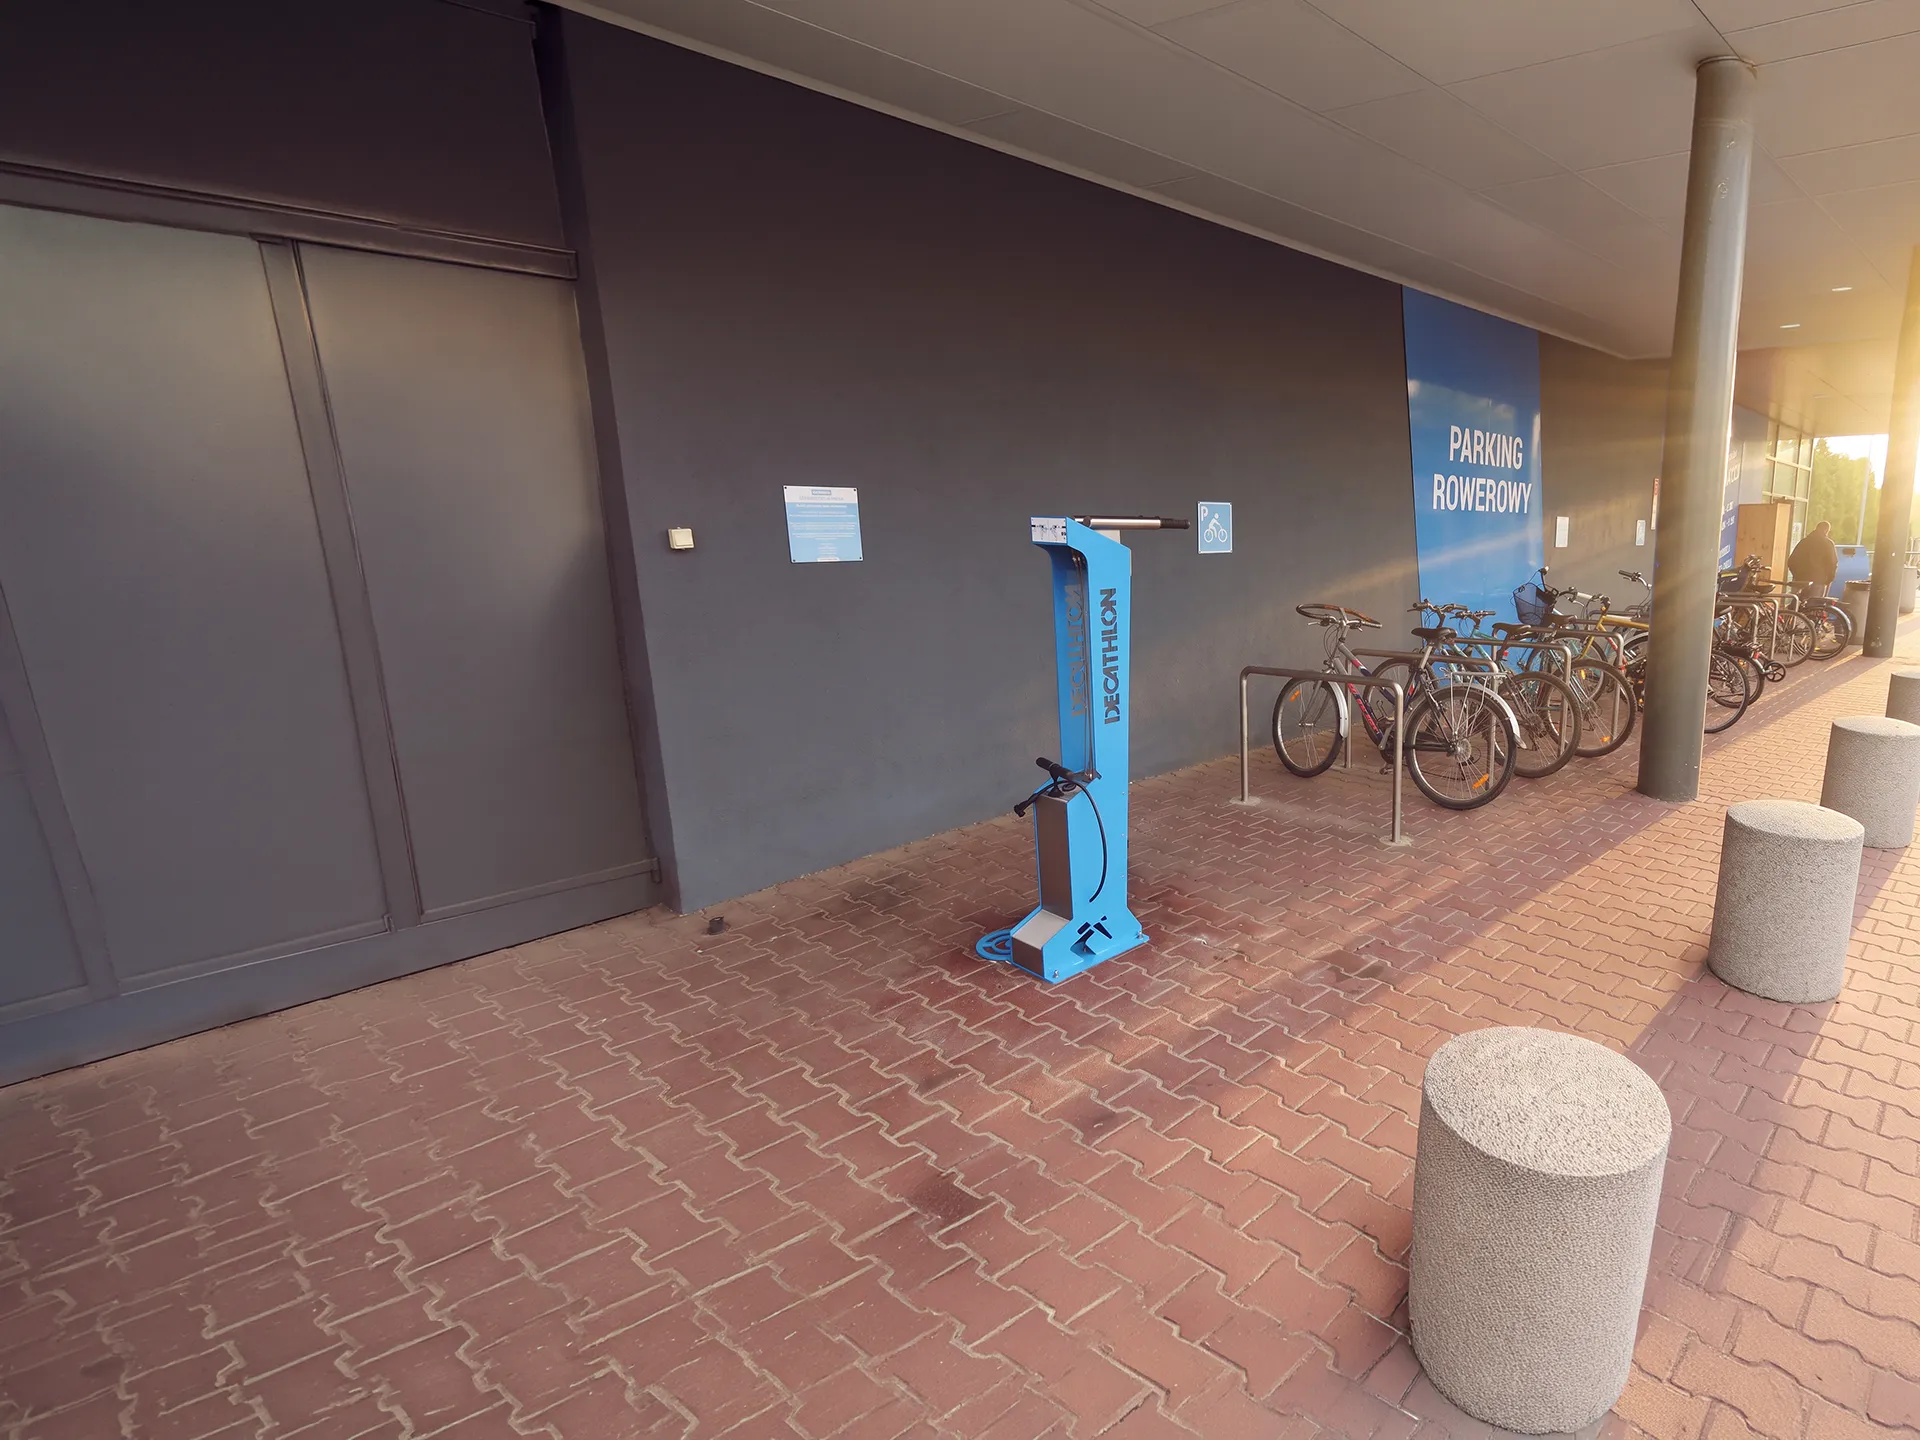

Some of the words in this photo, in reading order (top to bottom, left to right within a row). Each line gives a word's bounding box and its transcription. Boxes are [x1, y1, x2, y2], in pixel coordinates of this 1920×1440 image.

[1449, 425, 1523, 470] PARKING
[1200, 505, 1209, 522] P
[1433, 473, 1532, 514] ROWEROWY
[1100, 588, 1121, 725] DECATHLON
